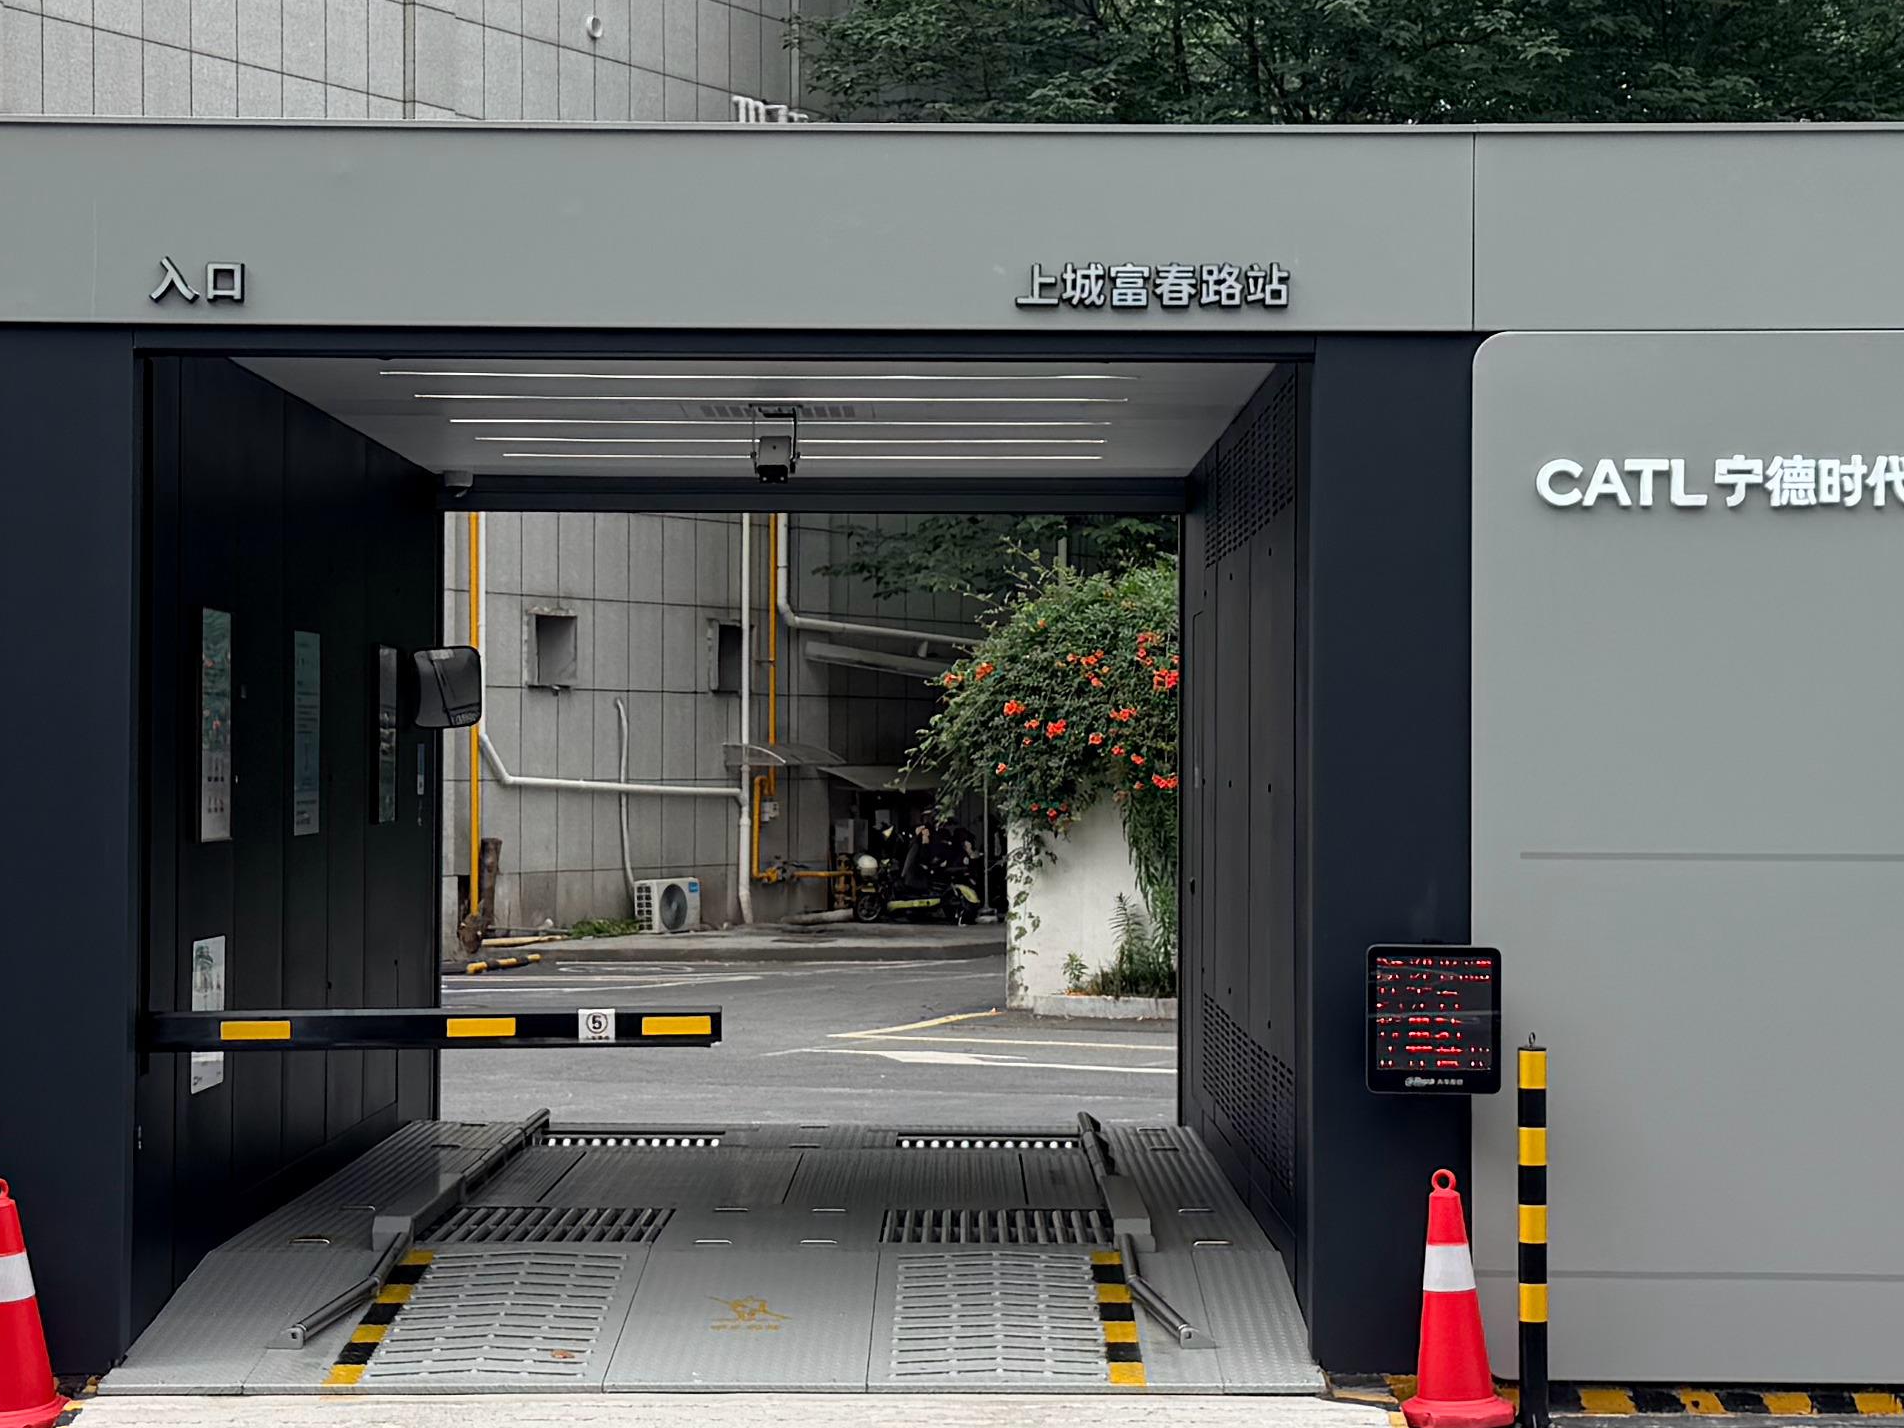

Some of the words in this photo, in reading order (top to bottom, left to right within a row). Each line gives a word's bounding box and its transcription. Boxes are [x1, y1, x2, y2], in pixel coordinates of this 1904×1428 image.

[149, 256, 245, 303] 入口
[1015, 262, 1291, 308] 上城富春路站
[1535, 458, 1708, 508] CATL
[592, 1015, 602, 1030] 5
